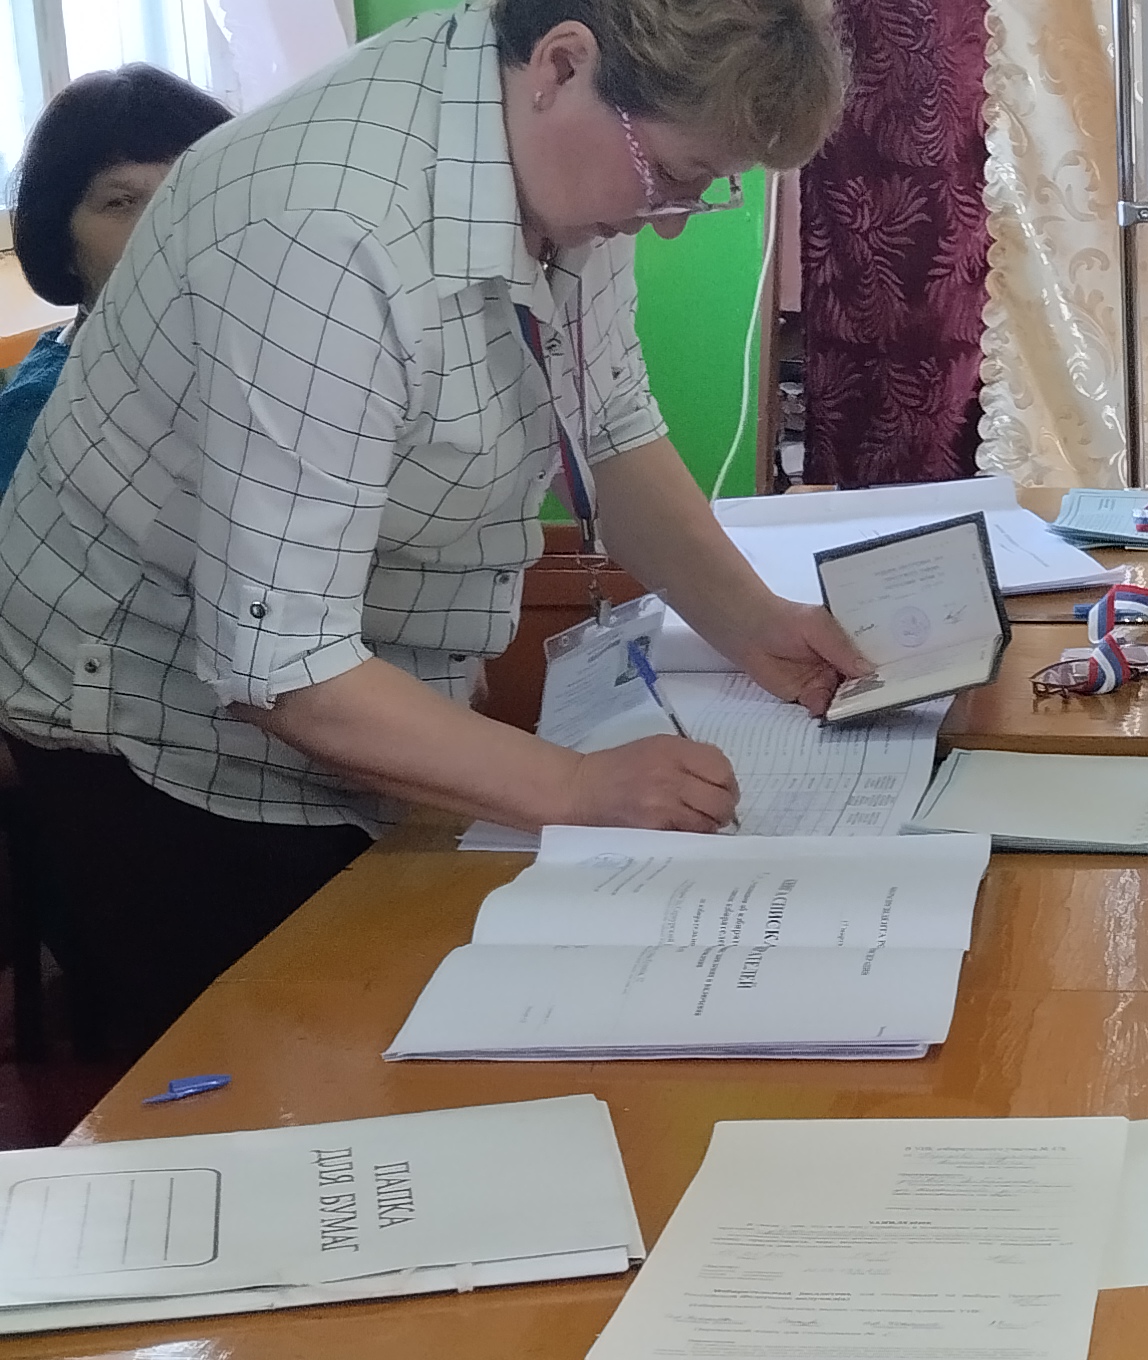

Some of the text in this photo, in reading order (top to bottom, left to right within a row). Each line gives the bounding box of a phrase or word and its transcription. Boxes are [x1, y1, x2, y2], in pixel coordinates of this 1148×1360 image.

[309, 1146, 360, 1252] ДЛЯ БУМАГ
[374, 1160, 417, 1230] ПАПКА
